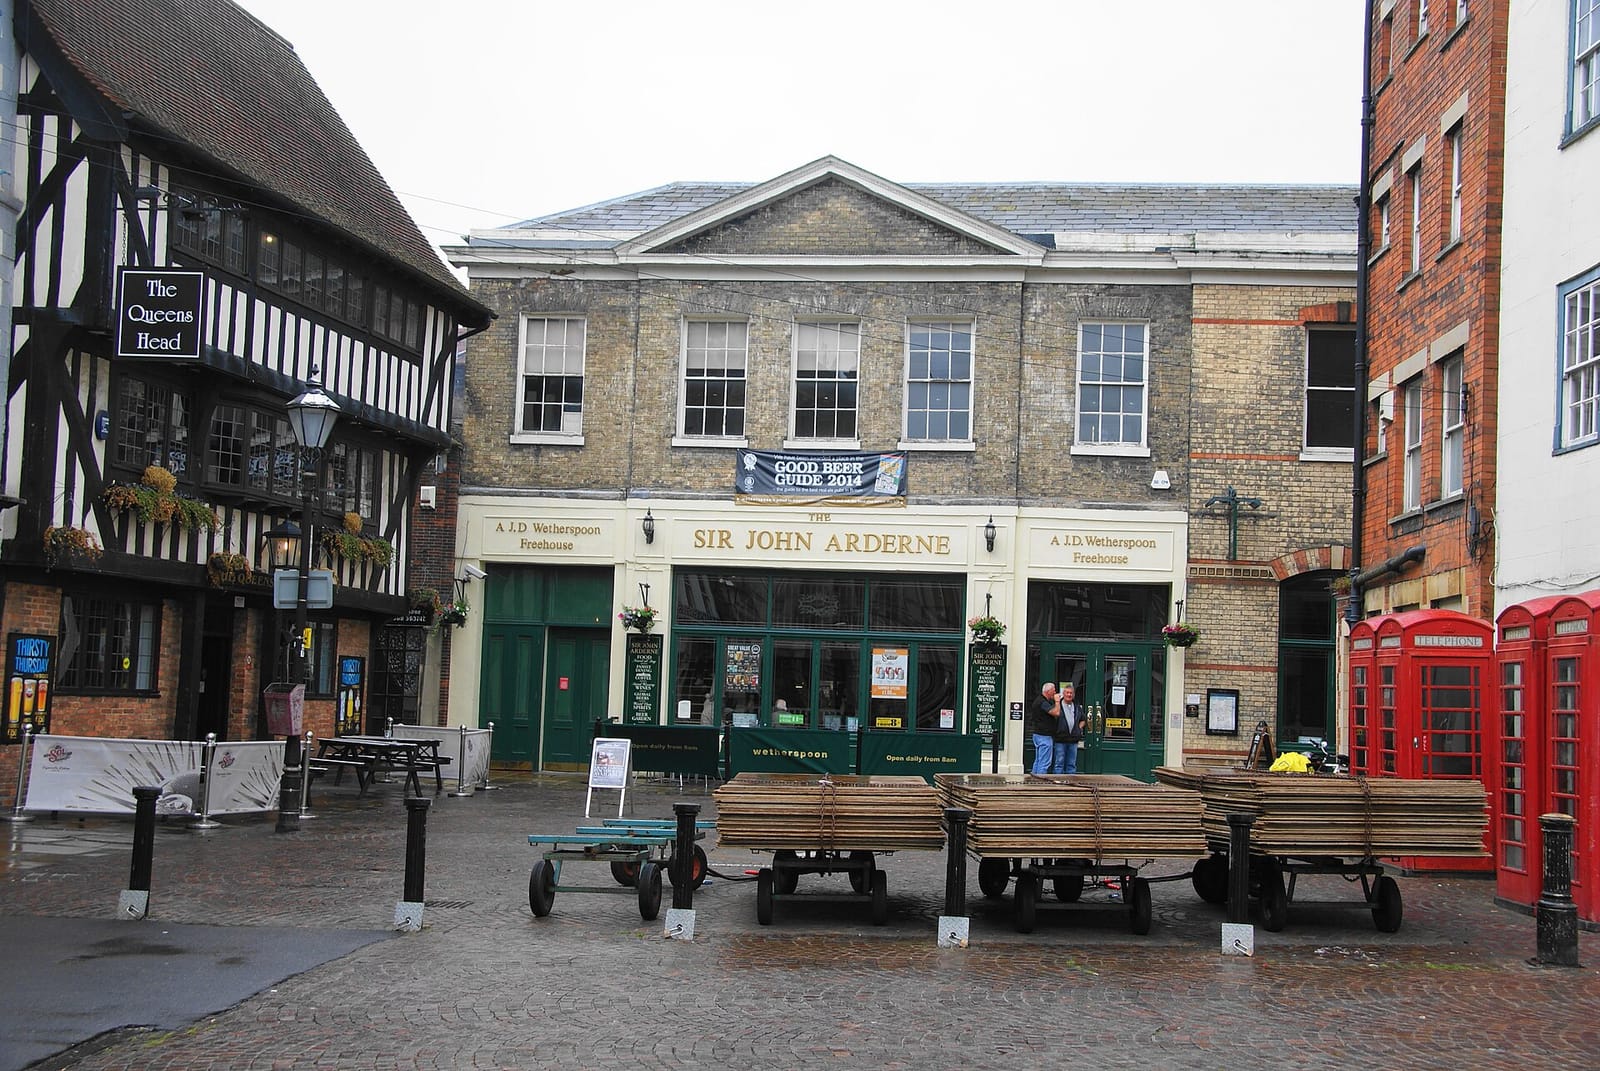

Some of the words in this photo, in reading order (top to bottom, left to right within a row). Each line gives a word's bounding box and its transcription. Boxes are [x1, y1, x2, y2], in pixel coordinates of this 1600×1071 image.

[146, 279, 177, 297] The
[128, 304, 194, 324] Queens
[136, 332, 181, 350] Head
[774, 461, 818, 473] GOOD
[822, 462, 863, 474] BEER
[774, 474, 823, 486] GUIDE
[828, 475, 862, 486] 2014
[809, 513, 831, 521] THE
[496, 522, 504, 532] A
[533, 523, 600, 536] Wetherspoon
[520, 538, 573, 550] Freehouse
[694, 529, 734, 549] SIR
[746, 530, 813, 550] JOHN
[825, 534, 950, 554] ARDERNE
[1051, 535, 1060, 545] A
[1064, 535, 1084, 546] J.D.
[1085, 536, 1156, 549] Wetherspoon
[1073, 552, 1128, 564] Freehouse
[16, 638, 49, 657] THIRSTY
[1418, 636, 1481, 646] TELEPHONE
[16, 657, 49, 673] THURSDAY
[753, 748, 828, 759] wetherspoon
[906, 755, 922, 763] daily
